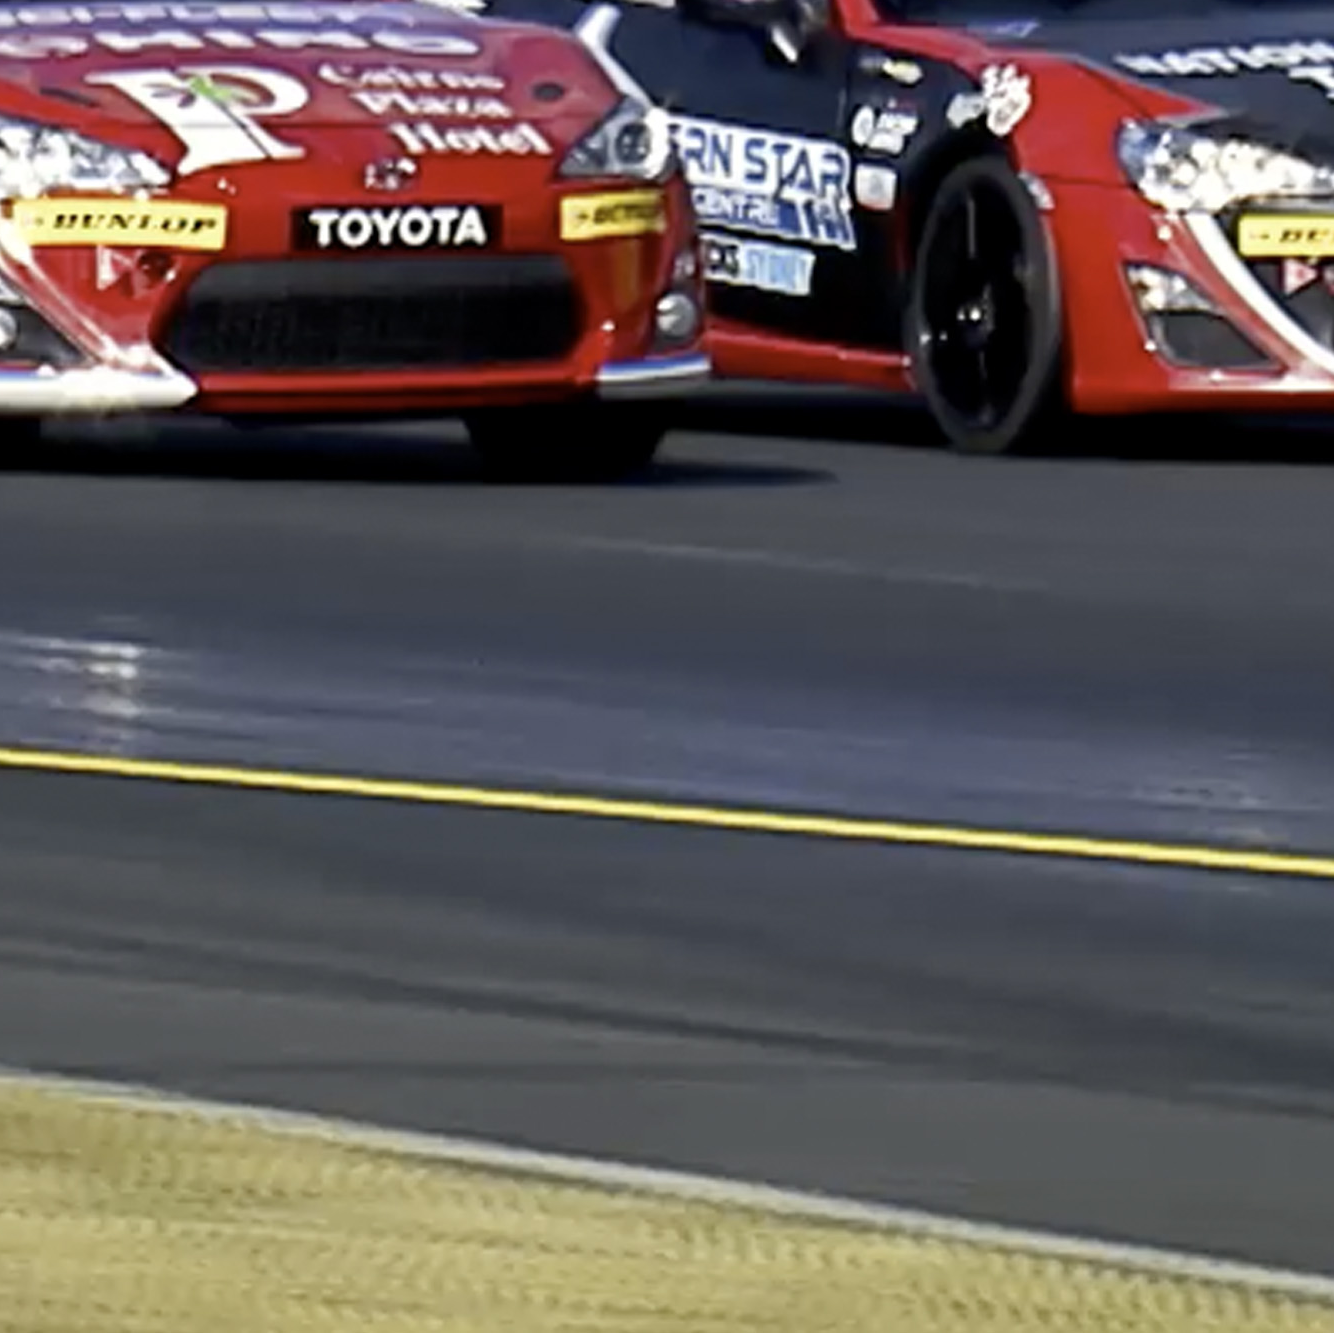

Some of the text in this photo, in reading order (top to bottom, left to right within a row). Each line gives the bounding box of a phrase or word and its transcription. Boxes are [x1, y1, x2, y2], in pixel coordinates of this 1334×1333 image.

[389, 121, 553, 155] Hotel
[743, 137, 847, 200] STAR
[53, 212, 217, 235] DUNLOP
[309, 207, 489, 248] TOYOTA
